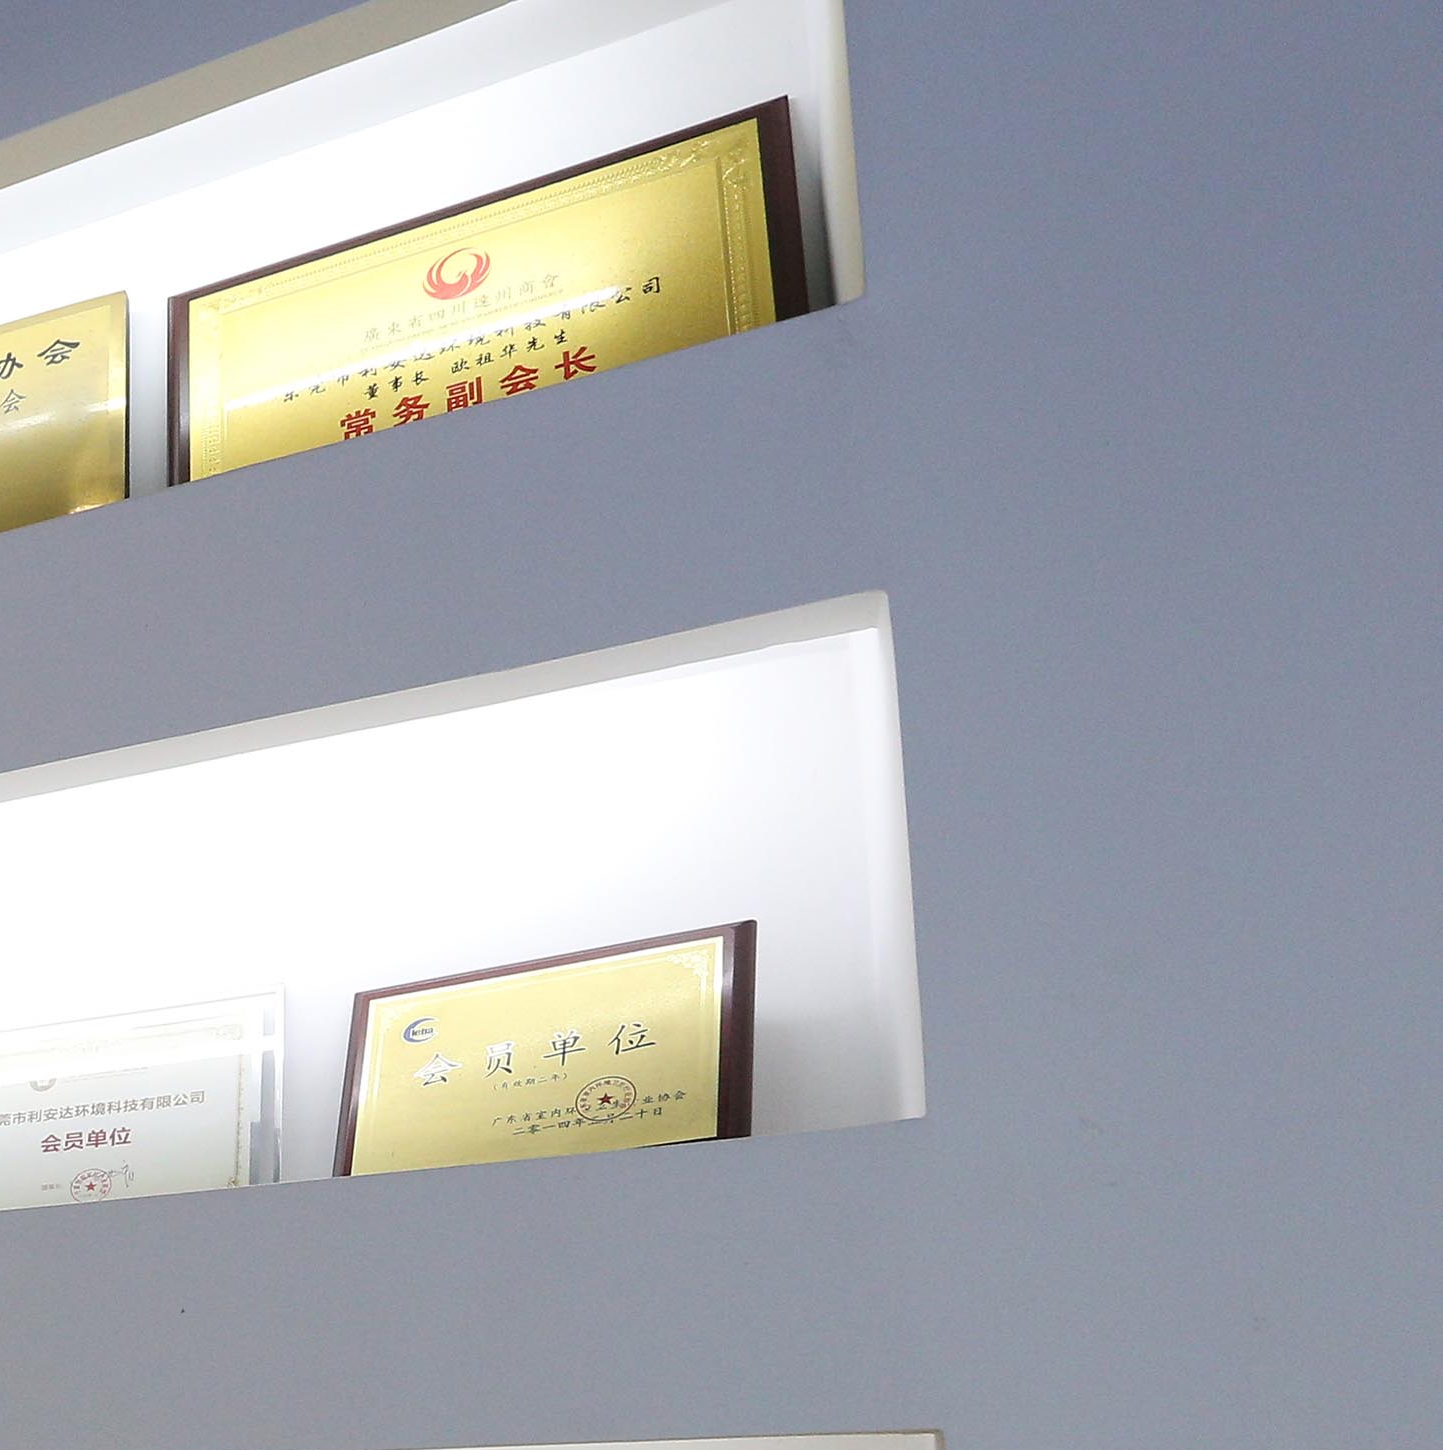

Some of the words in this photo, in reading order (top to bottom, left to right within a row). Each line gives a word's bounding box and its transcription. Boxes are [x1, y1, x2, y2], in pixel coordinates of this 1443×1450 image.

[339, 345, 599, 441] 常务副会长
[413, 1022, 657, 1088] 会员单位
[40, 1126, 132, 1153] 会员单位
